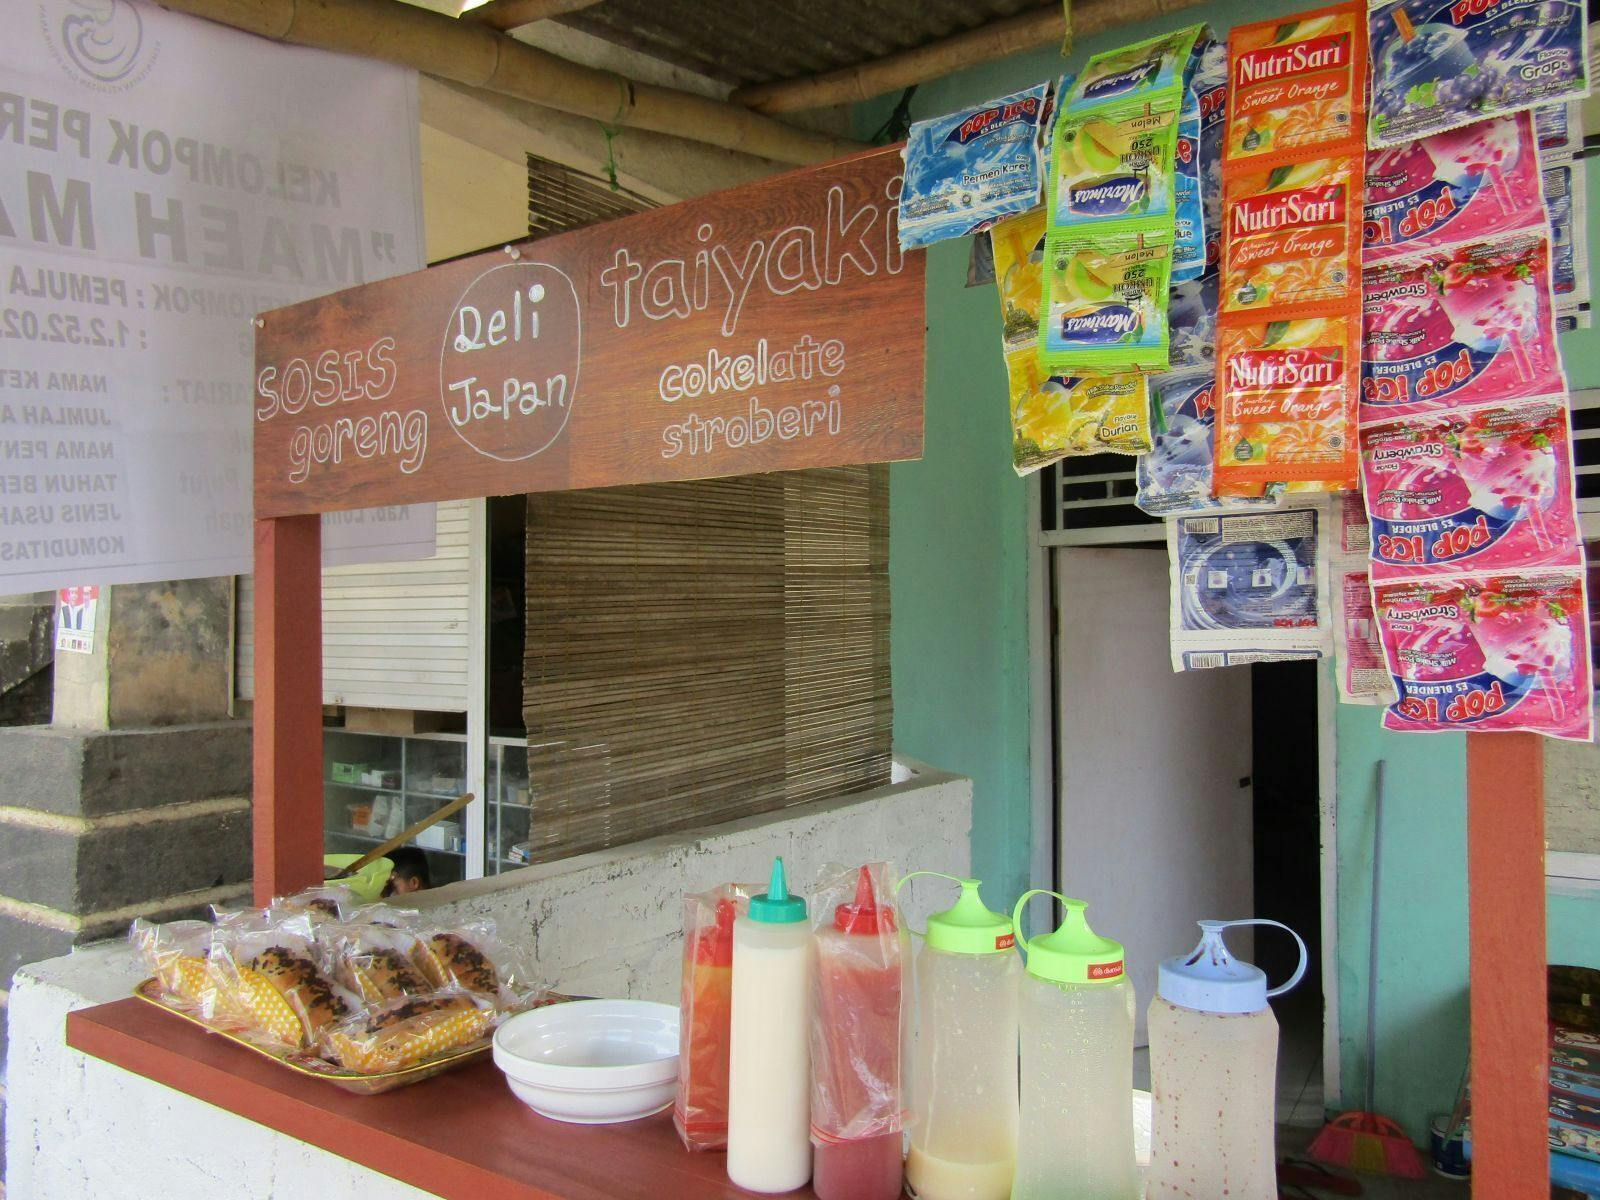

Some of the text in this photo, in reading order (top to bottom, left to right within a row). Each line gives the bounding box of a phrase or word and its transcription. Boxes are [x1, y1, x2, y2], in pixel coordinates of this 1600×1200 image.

[1239, 44, 1341, 85] NutriSari
[1520, 60, 1570, 80] Grape
[1241, 81, 1339, 111] Sweet Orange
[960, 108, 1000, 143] POP
[1130, 115, 1161, 129] Melon
[1131, 137, 1153, 151] 250
[962, 163, 1030, 185] Permen Karet
[1074, 180, 1145, 204] Marimas
[1234, 194, 1336, 235] NutriSari
[1399, 186, 1456, 237] POP
[601, 175, 905, 337] taiyaki
[1125, 249, 1155, 261] Melon
[1237, 237, 1335, 263] Sweet Orange
[1123, 268, 1146, 281] 250
[1365, 283, 1427, 303] Strawberr
[454, 283, 546, 353] Deli
[1067, 312, 1137, 334] Marimas
[659, 334, 846, 402] cokelate
[1229, 354, 1333, 387] NutriSari
[1416, 348, 1474, 397] POP
[1424, 355, 1437, 367] ES
[257, 336, 398, 422] SOSIS
[449, 373, 568, 427] Japan
[1232, 400, 1277, 417] Sweet
[1279, 398, 1331, 419] Orange
[661, 384, 842, 459] stroberi
[1101, 423, 1138, 438] Durian
[288, 409, 429, 484] goreng
[1373, 444, 1442, 461] Strawberry
[1391, 518, 1454, 534] ES BLENDER
[1431, 515, 1491, 559] POP
[1387, 605, 1458, 623] Strawberry
[1405, 681, 1469, 695] ES BLENDER
[1446, 681, 1506, 724] POP
